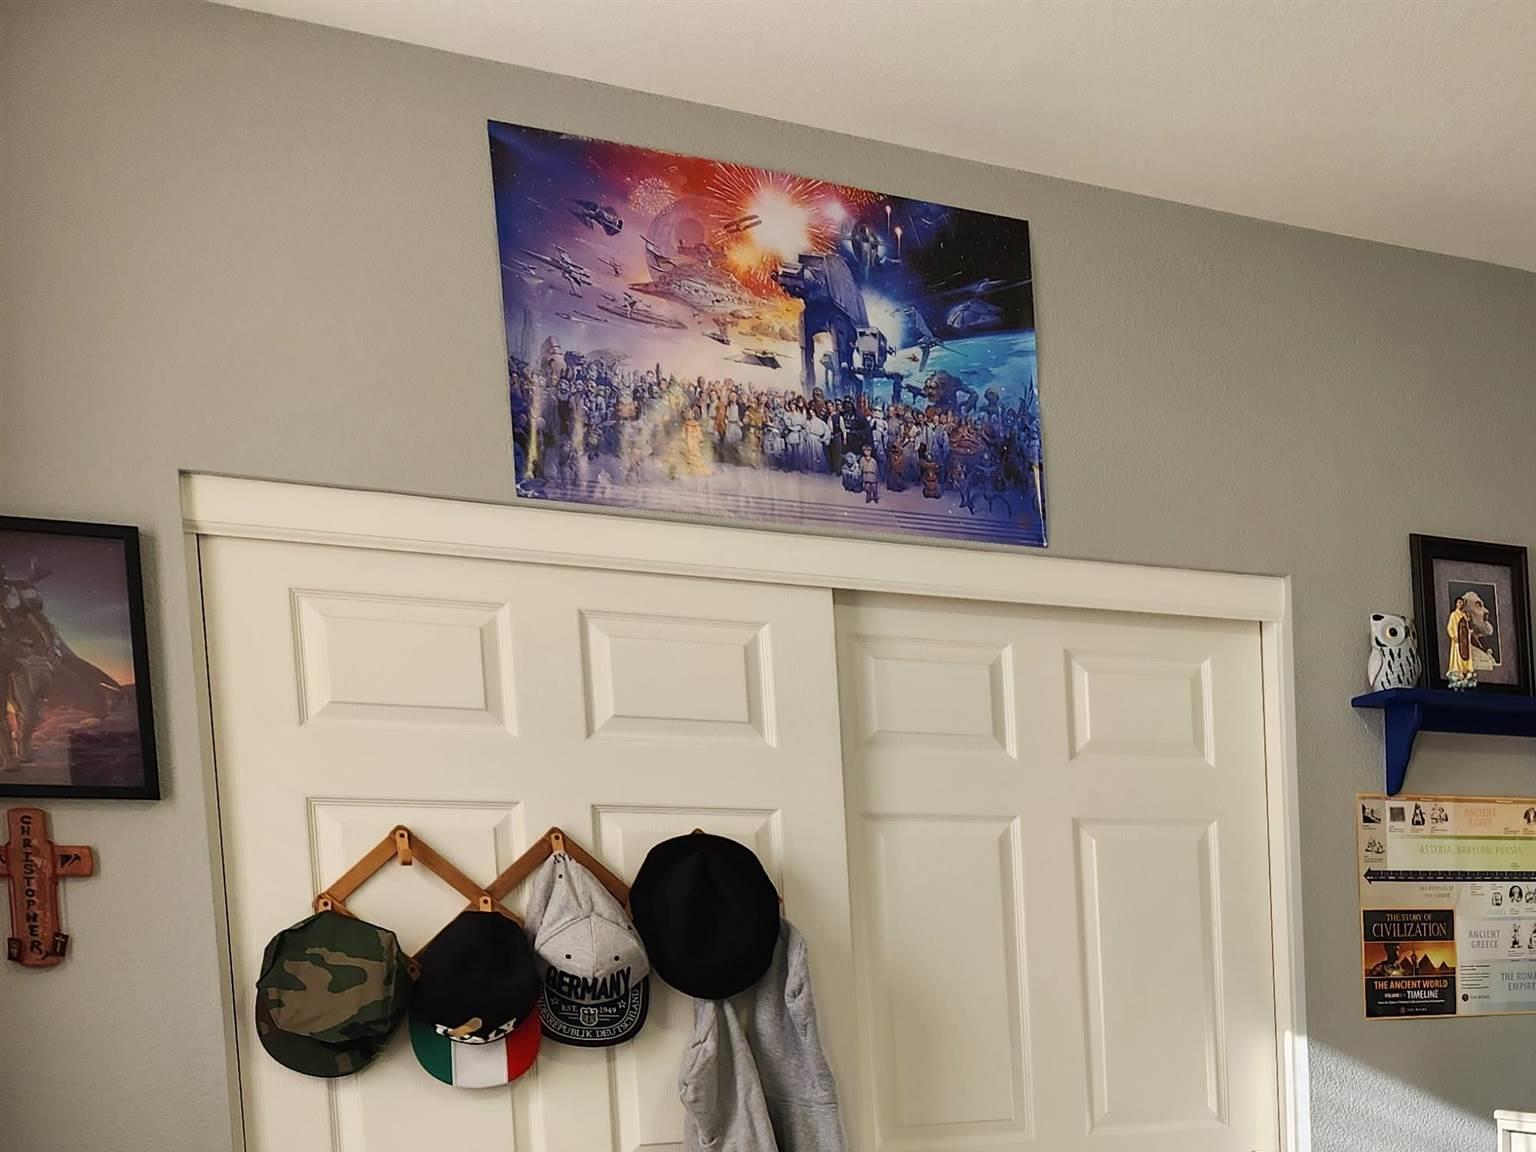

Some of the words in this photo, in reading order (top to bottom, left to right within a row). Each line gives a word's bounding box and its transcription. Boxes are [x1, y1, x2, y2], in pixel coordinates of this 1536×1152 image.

[20, 815, 43, 955] CHRISTOPHER
[1387, 913, 1400, 922] THE
[1401, 913, 1422, 921] STORY
[1372, 922, 1447, 937] CIVILIZATION
[1468, 929, 1500, 938] ANCIENT
[1471, 940, 1499, 949] GREECE
[1501, 972, 1515, 981] THE
[1374, 981, 1388, 990] THE
[1389, 980, 1421, 989] ANCIENT
[1422, 979, 1449, 988] WORLD
[1508, 982, 1536, 991] EMPIRE
[1406, 989, 1439, 999] TIMELINE
[561, 1004, 578, 1012] EST.
[599, 1006, 617, 1014] 1949
[595, 988, 640, 1038] DEUTSCHLAND
